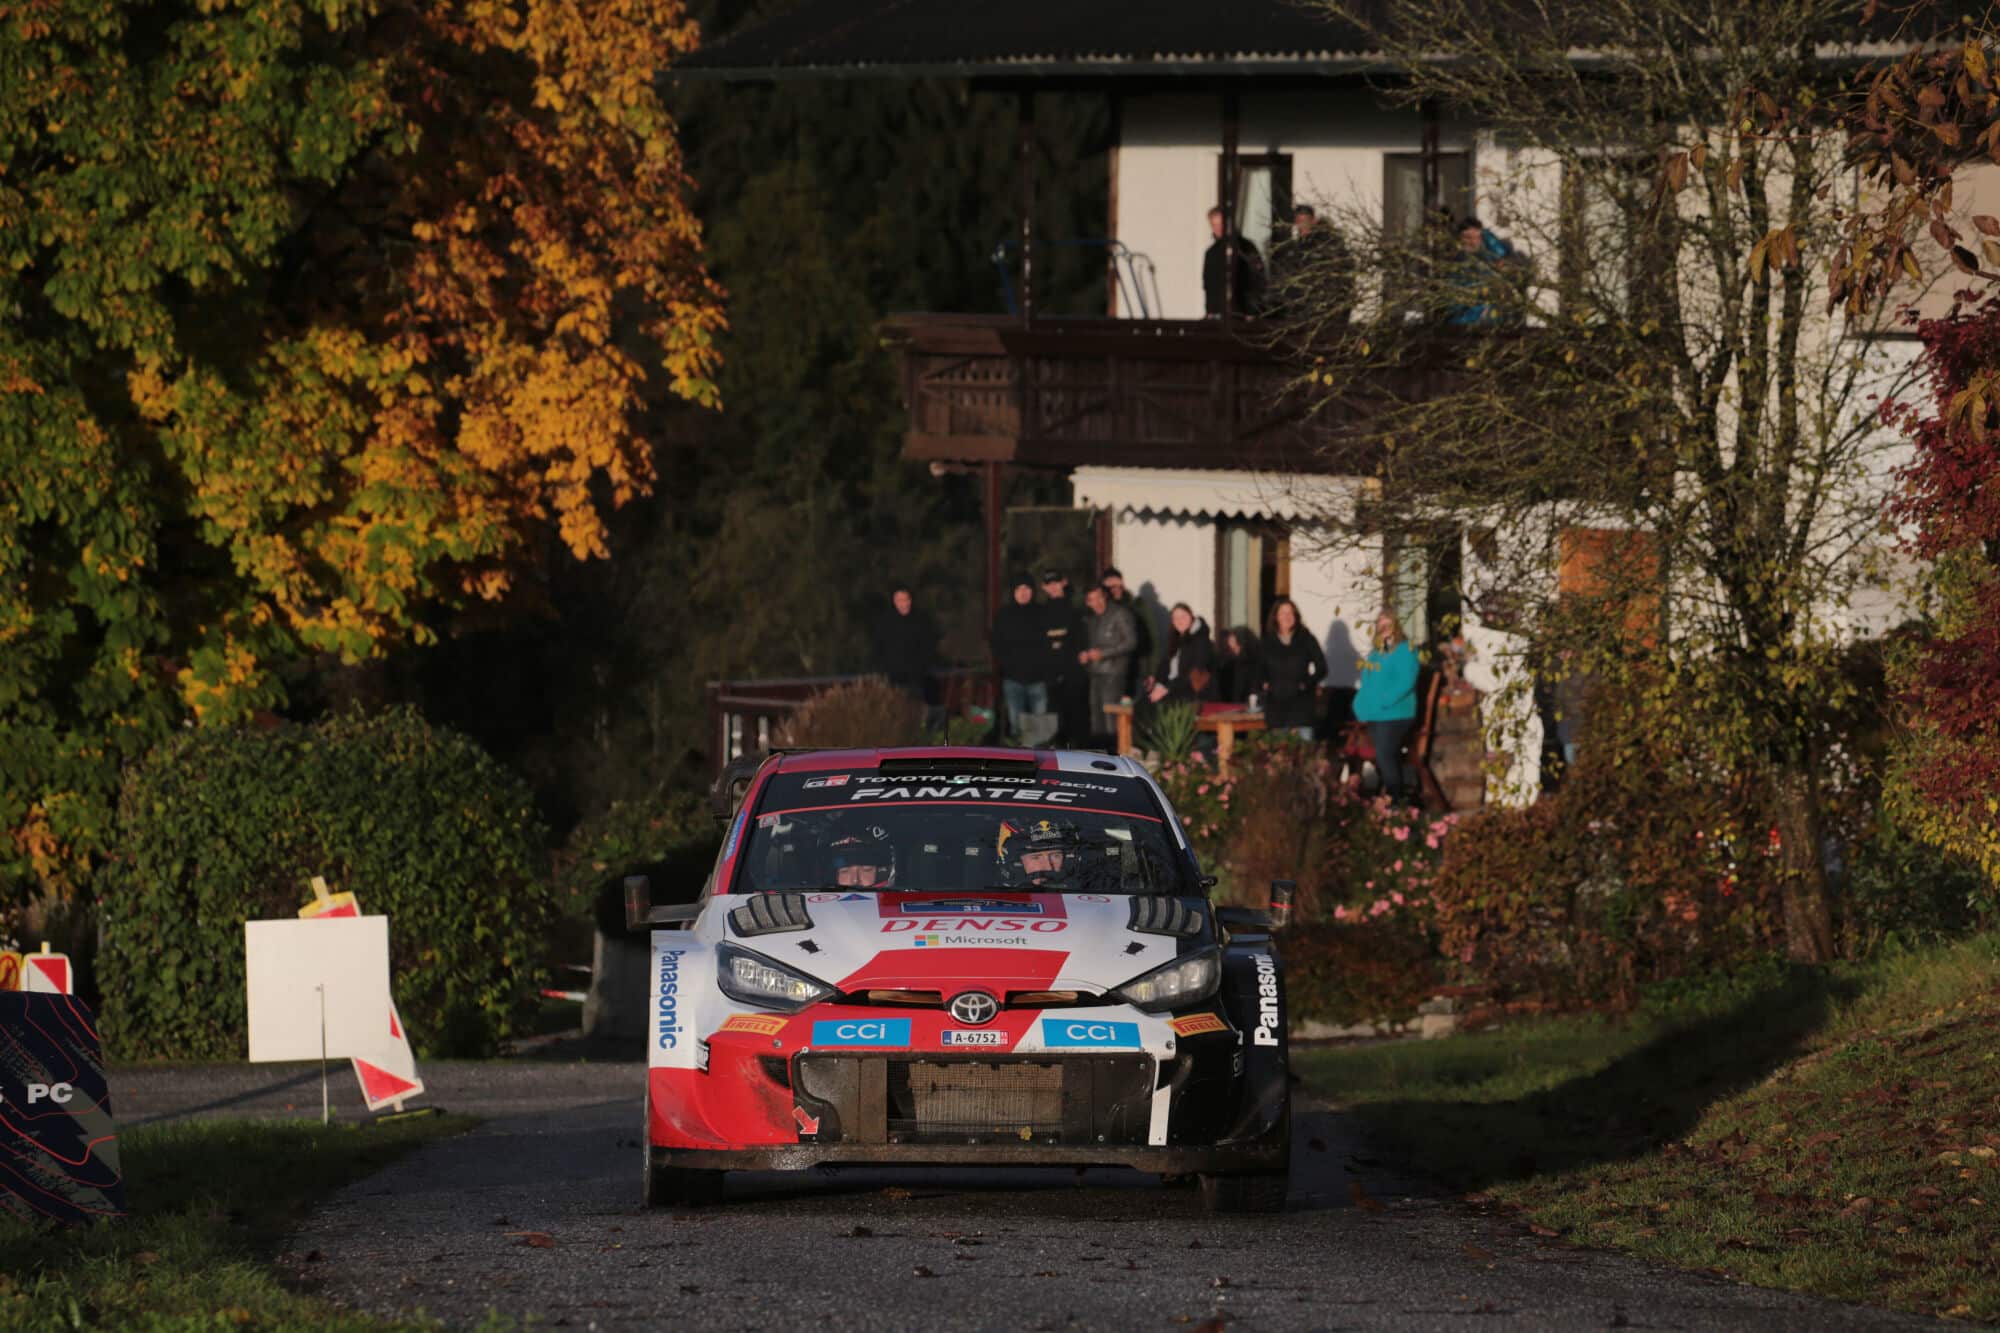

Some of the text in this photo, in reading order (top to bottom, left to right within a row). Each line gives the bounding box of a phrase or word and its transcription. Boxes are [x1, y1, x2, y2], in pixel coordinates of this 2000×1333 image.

[804, 776, 848, 788] GR
[856, 775, 1119, 793] TOYOTA GAZOO Racing
[850, 787, 1080, 803] FANATEC
[880, 918, 1068, 933] DENSO
[945, 935, 1027, 946] Microsoft
[659, 950, 686, 1049] Panasonic
[724, 1016, 783, 1033] PIRELLI
[1176, 1015, 1223, 1033] PIRELLI
[955, 1031, 997, 1043] A-6752
[27, 1082, 73, 1104] PC
